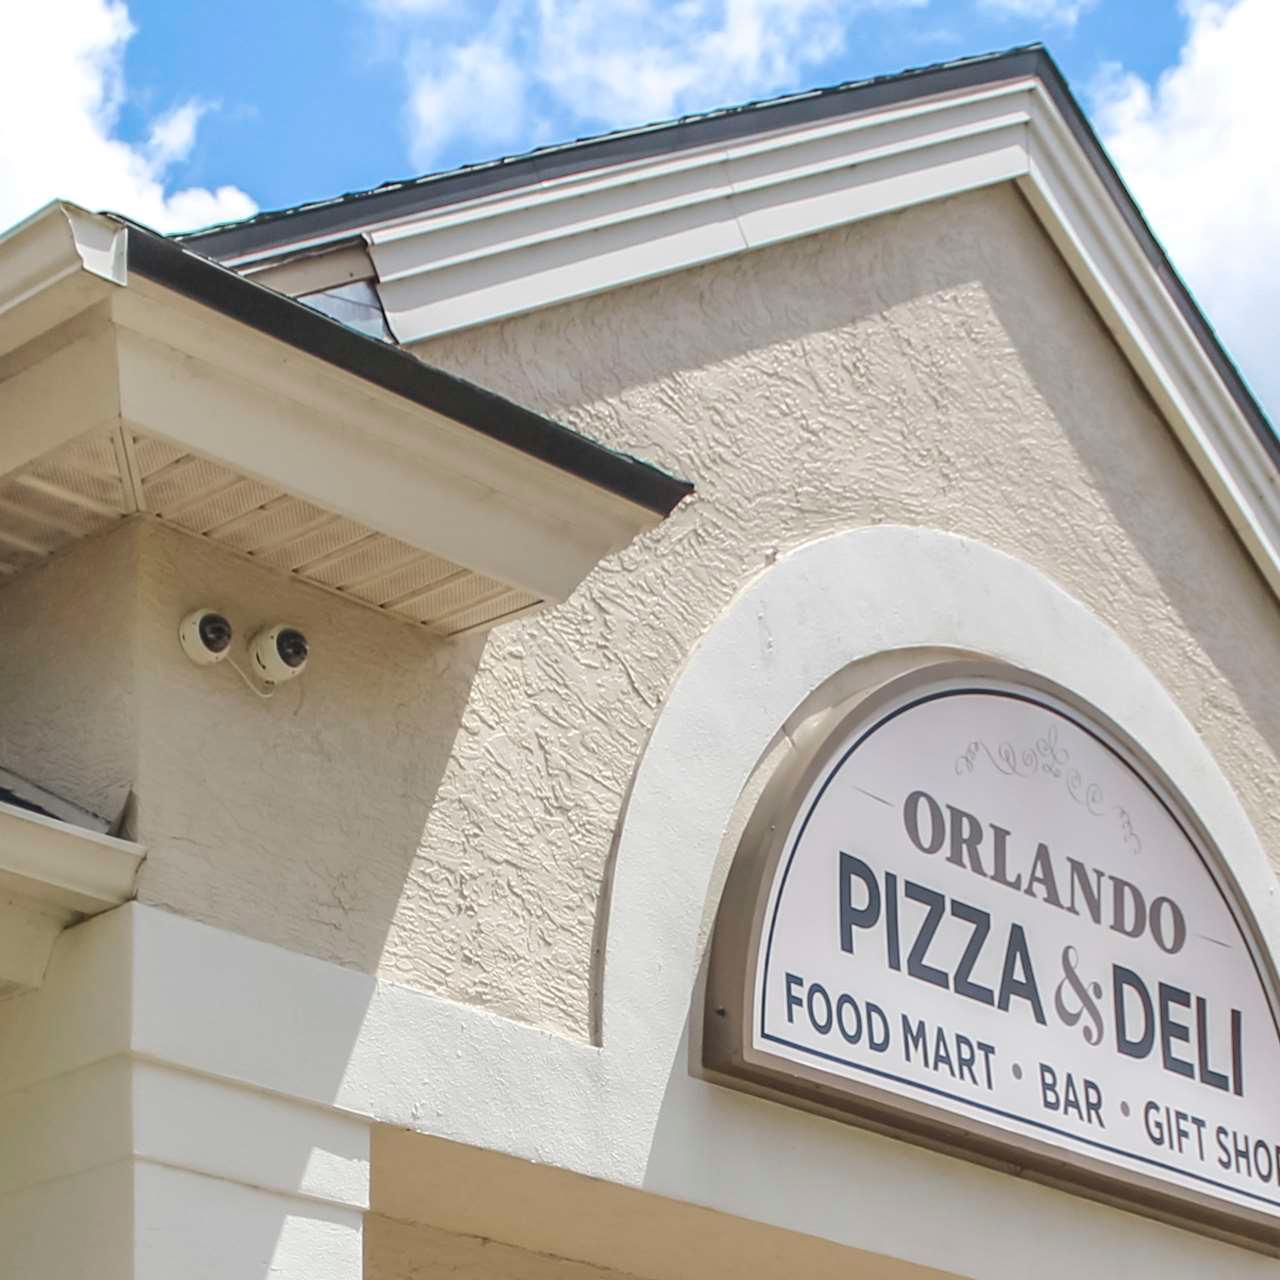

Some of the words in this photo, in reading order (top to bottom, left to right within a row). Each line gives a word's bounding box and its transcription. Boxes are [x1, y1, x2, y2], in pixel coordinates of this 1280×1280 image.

[903, 790, 1187, 955] ORLANDO
[785, 972, 890, 1053] FOOD
[901, 1014, 996, 1090] MART
[1039, 1063, 1105, 1129] BAR
[1144, 1101, 1206, 1162] GIFT
[839, 851, 1048, 1027] PIZZA
[1054, 945, 1104, 1046] &
[1112, 962, 1244, 1097] DELI
